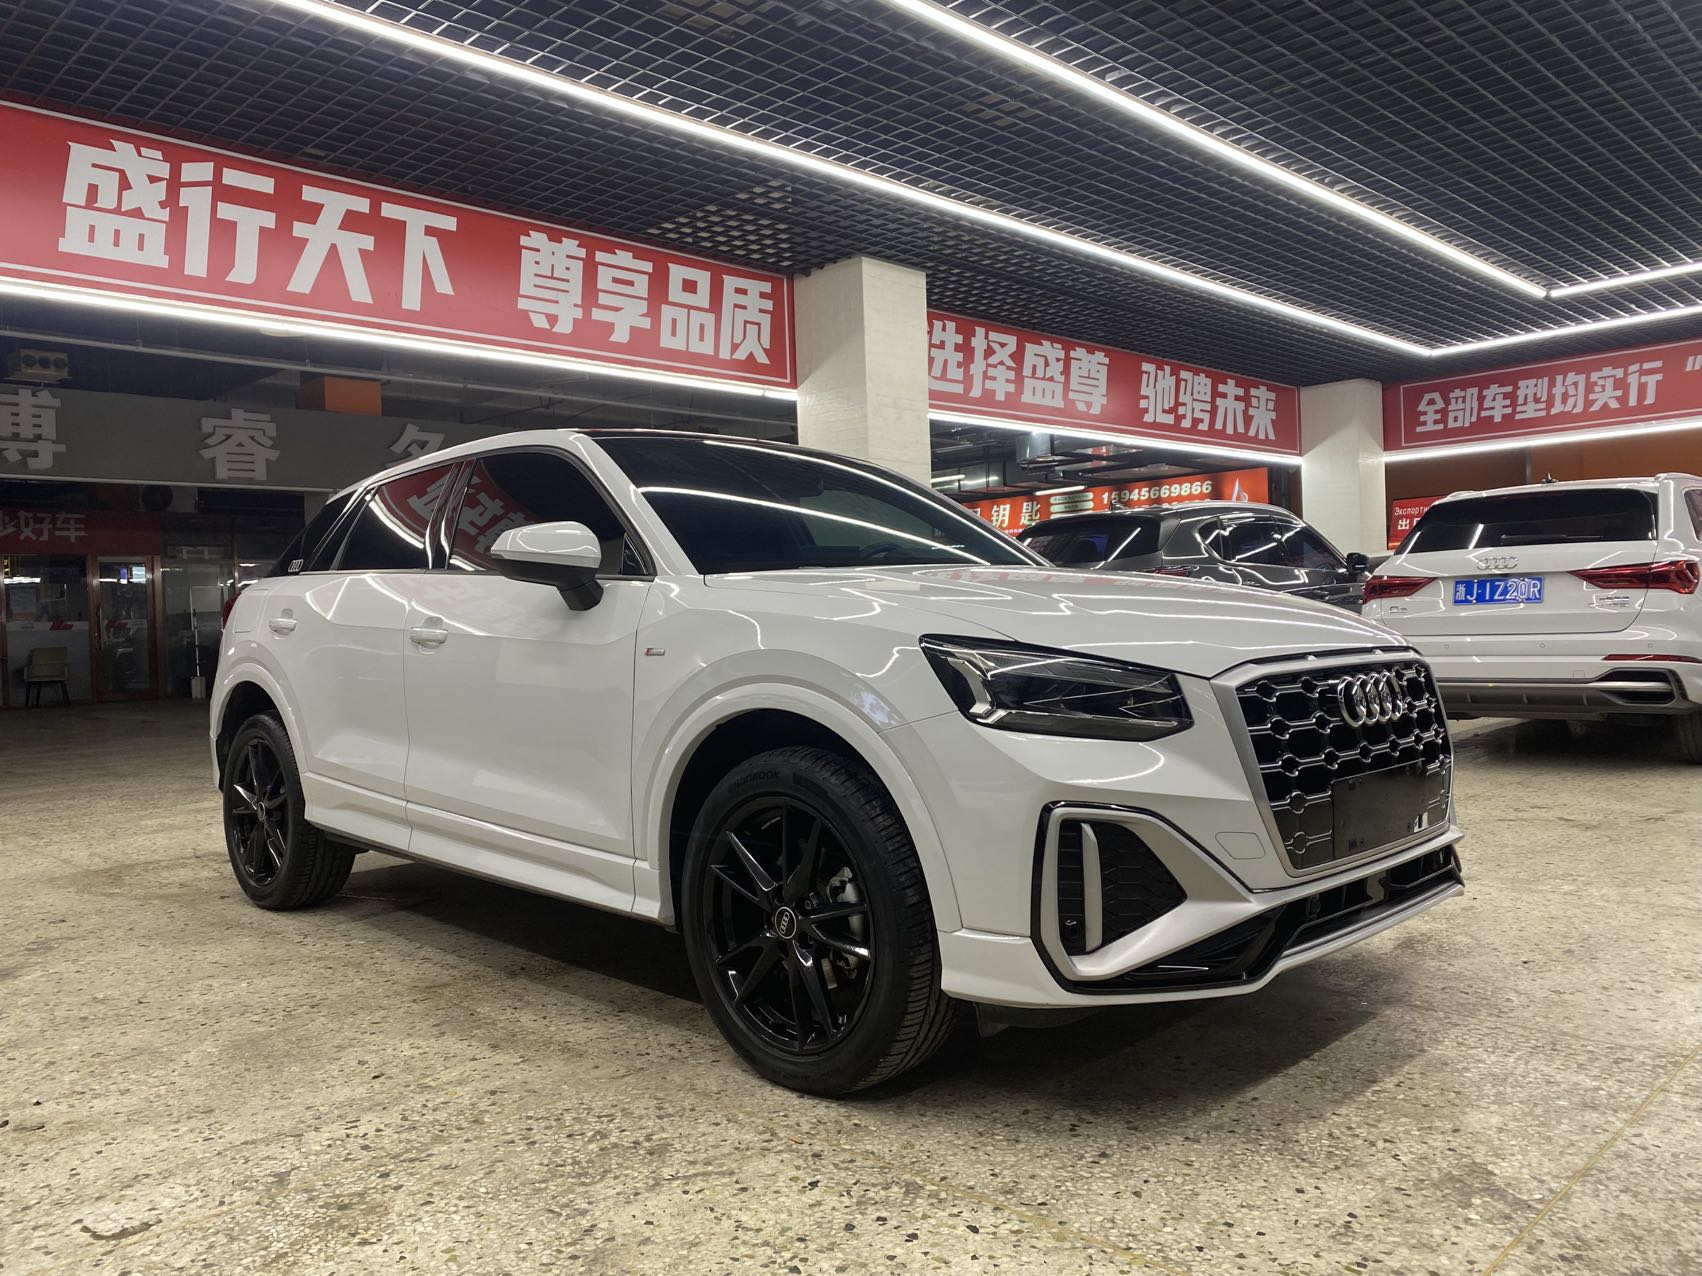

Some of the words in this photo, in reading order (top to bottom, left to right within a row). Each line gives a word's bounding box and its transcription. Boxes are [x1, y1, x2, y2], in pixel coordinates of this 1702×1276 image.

[58, 139, 457, 311] 盛行天下
[517, 230, 774, 365] 尊享品质
[928, 319, 1110, 415] 选择盛尊
[1139, 361, 1277, 441] 驰骋未来
[1415, 359, 1664, 433] 全部车型均实行
[1102, 480, 1213, 504] 15945669866
[1397, 517, 1421, 530] 出
